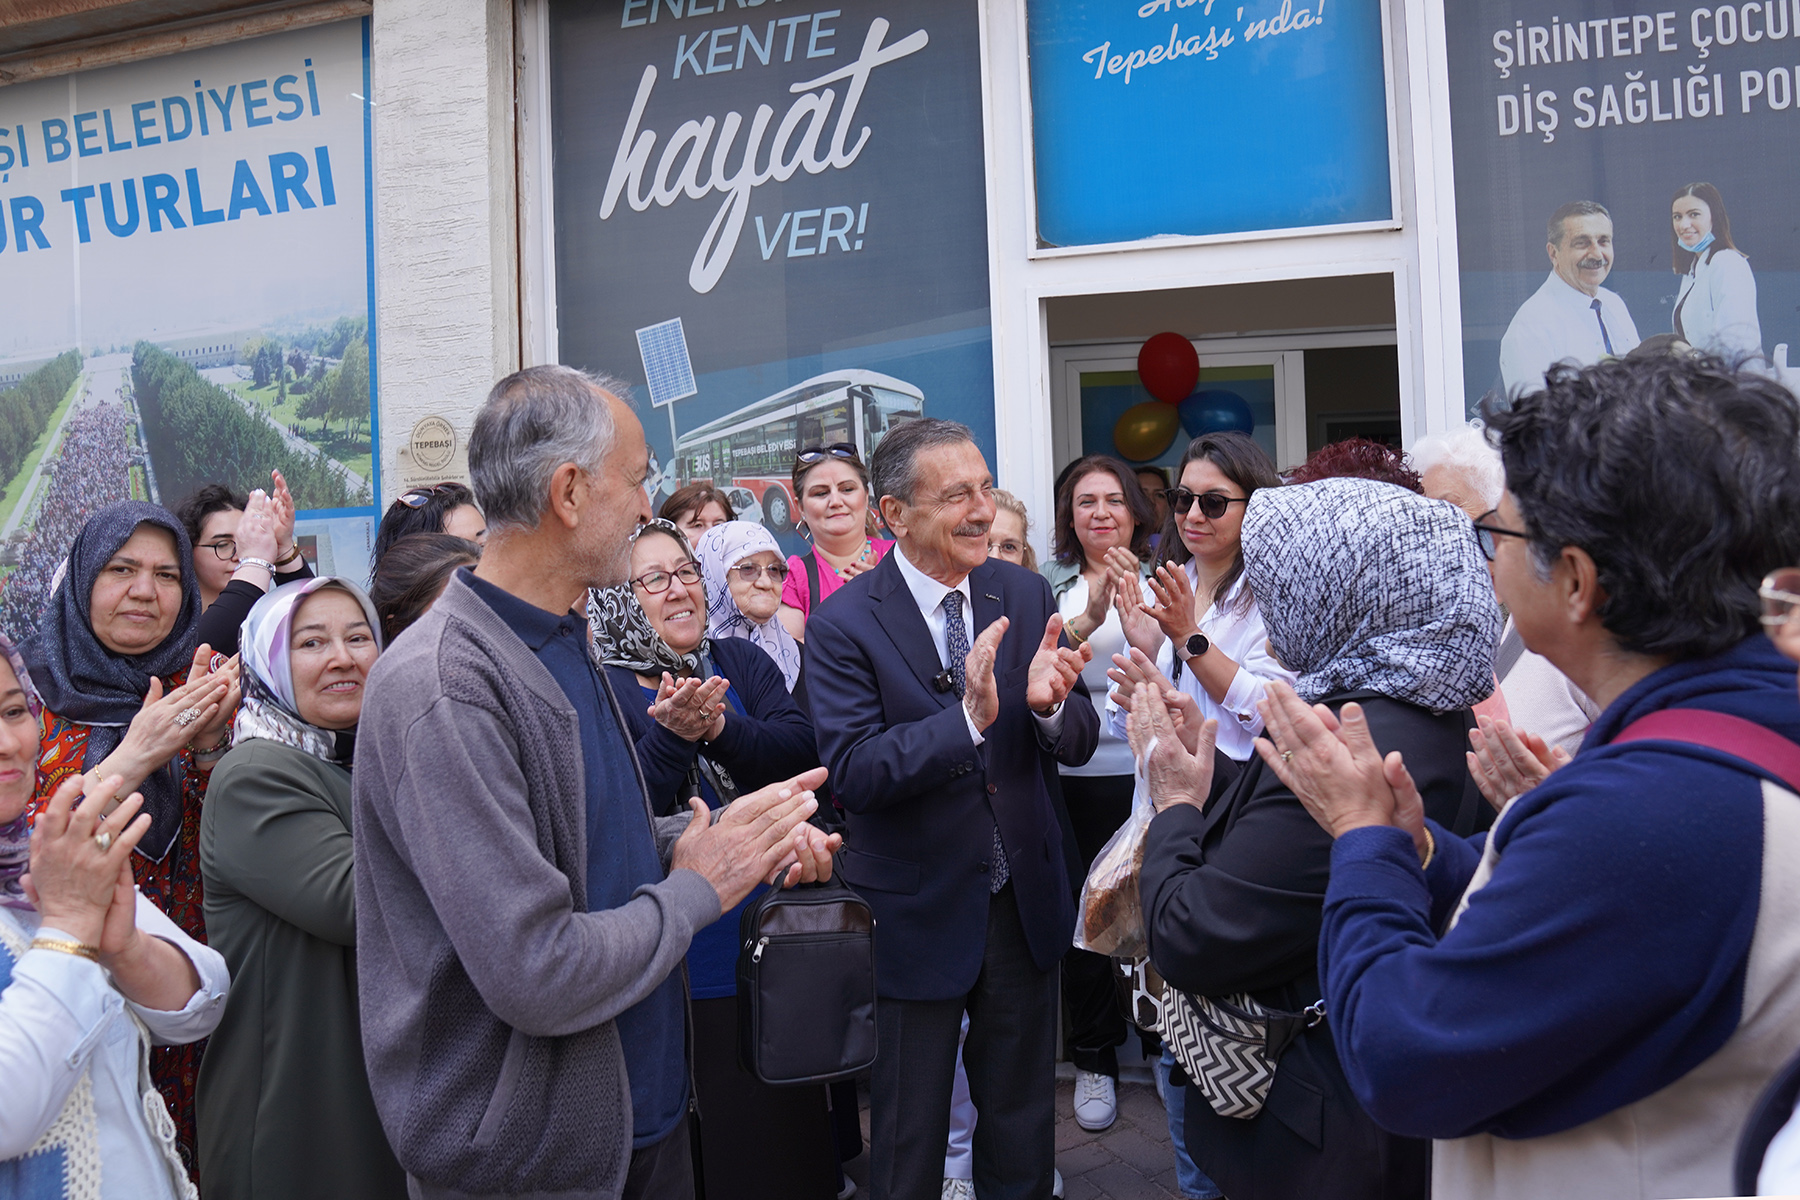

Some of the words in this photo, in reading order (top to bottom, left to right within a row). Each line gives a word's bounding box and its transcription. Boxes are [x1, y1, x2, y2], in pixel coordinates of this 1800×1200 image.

[672, 9, 842, 80] KENTE
[1082, 0, 1326, 85] Tepebaşı'nda!
[1492, 11, 1678, 79] ŞİRİNTEPE
[42, 58, 321, 164] BELEDİYESİ
[1496, 83, 1560, 144] DİŞ
[1572, 64, 1724, 130] SAĞLIĞI
[60, 145, 337, 244] TURLARI
[599, 16, 930, 294] hayat
[754, 202, 869, 261] VER!
[414, 440, 452, 449] TEPEBAŞI
